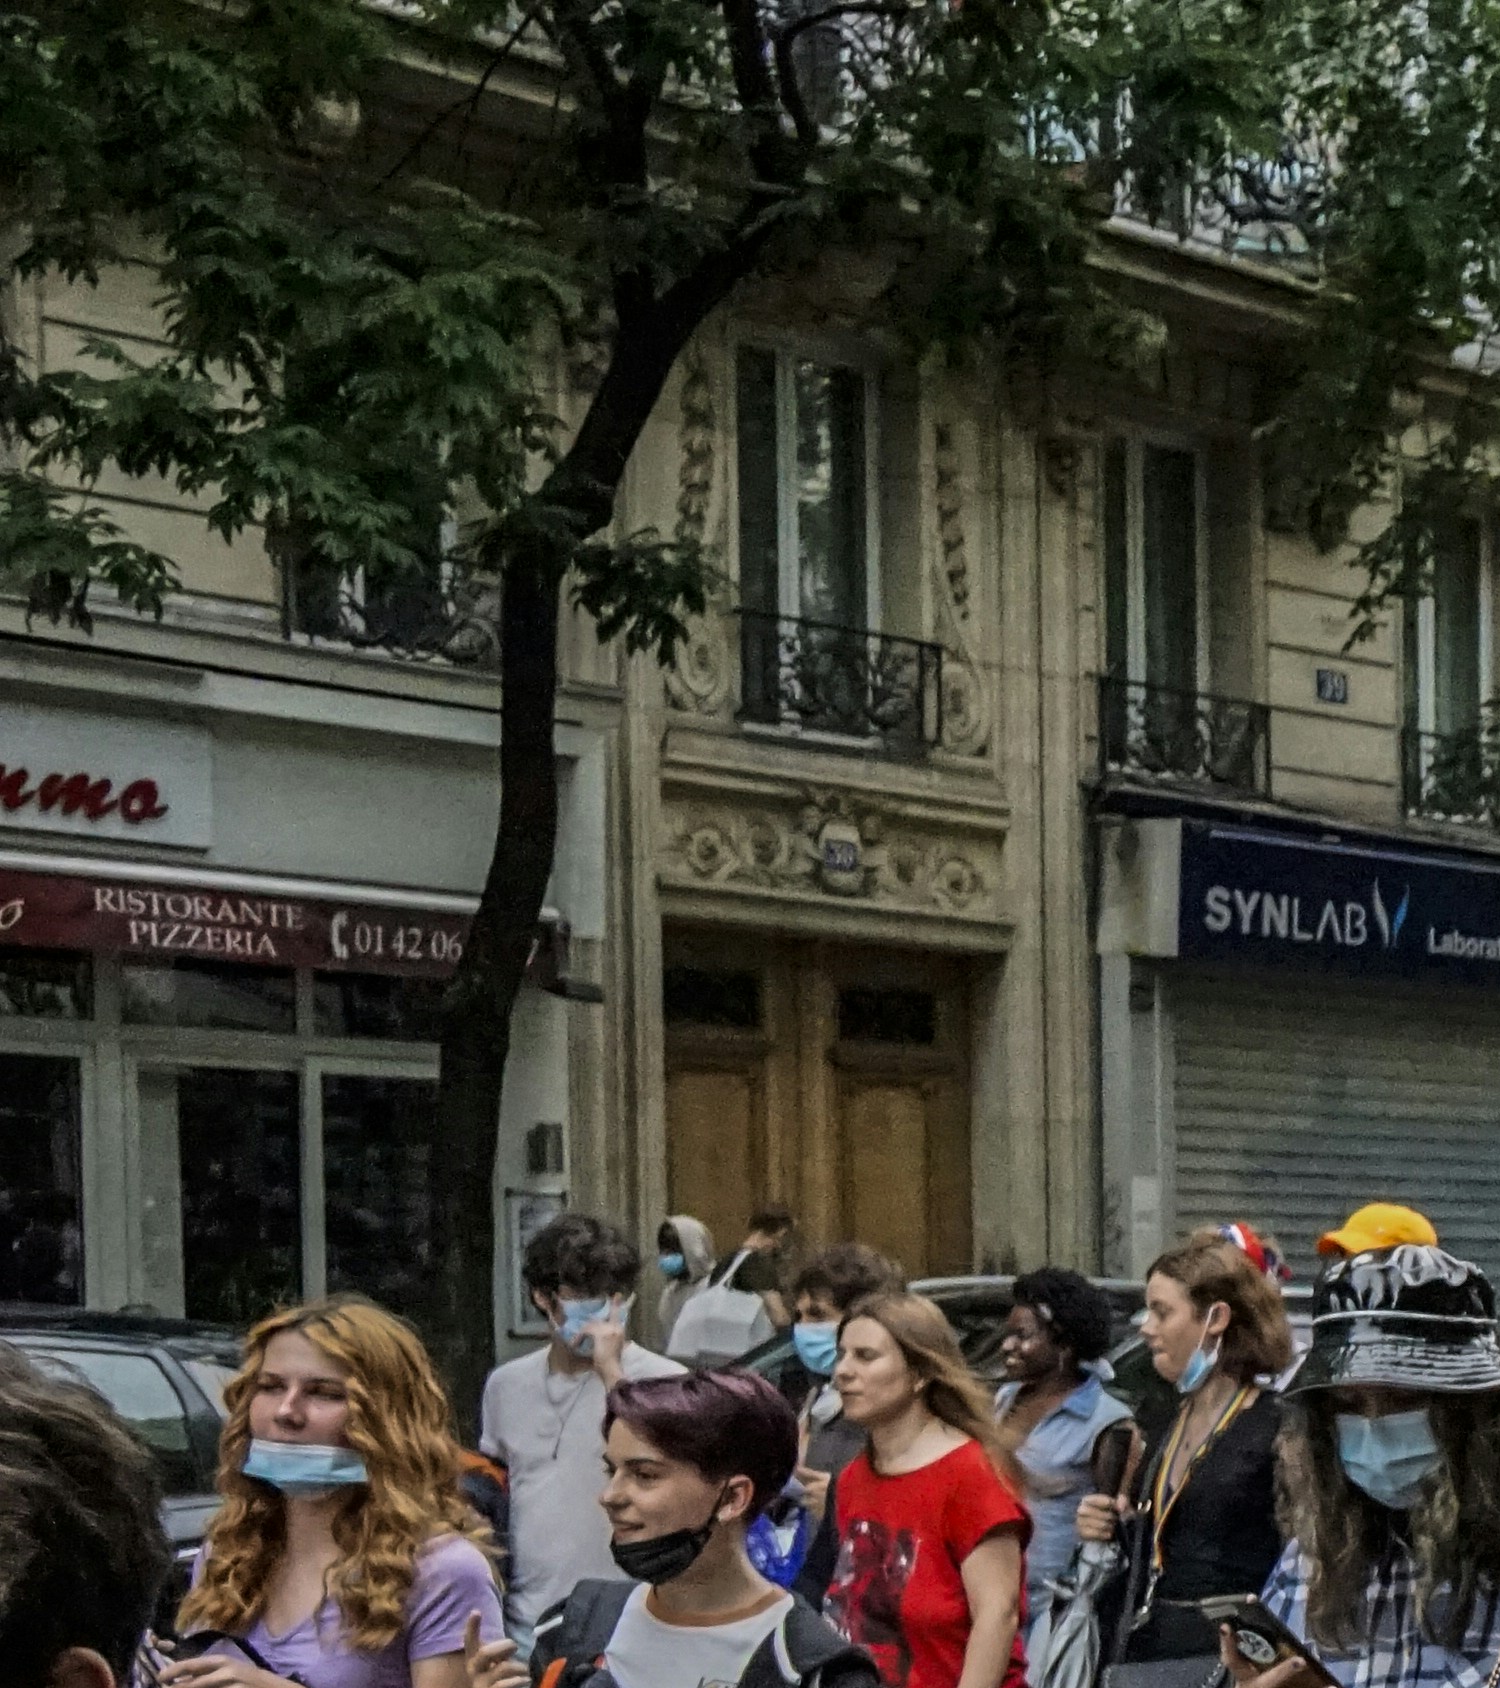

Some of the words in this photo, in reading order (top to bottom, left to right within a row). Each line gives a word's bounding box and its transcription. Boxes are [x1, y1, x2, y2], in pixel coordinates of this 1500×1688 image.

[93, 887, 304, 931] RISTORANTE
[1204, 885, 1368, 946] SYNLAB
[128, 919, 278, 958] PIZZERIA
[354, 920, 384, 955] 01
[392, 926, 423, 960] 42
[430, 930, 463, 964] 06
